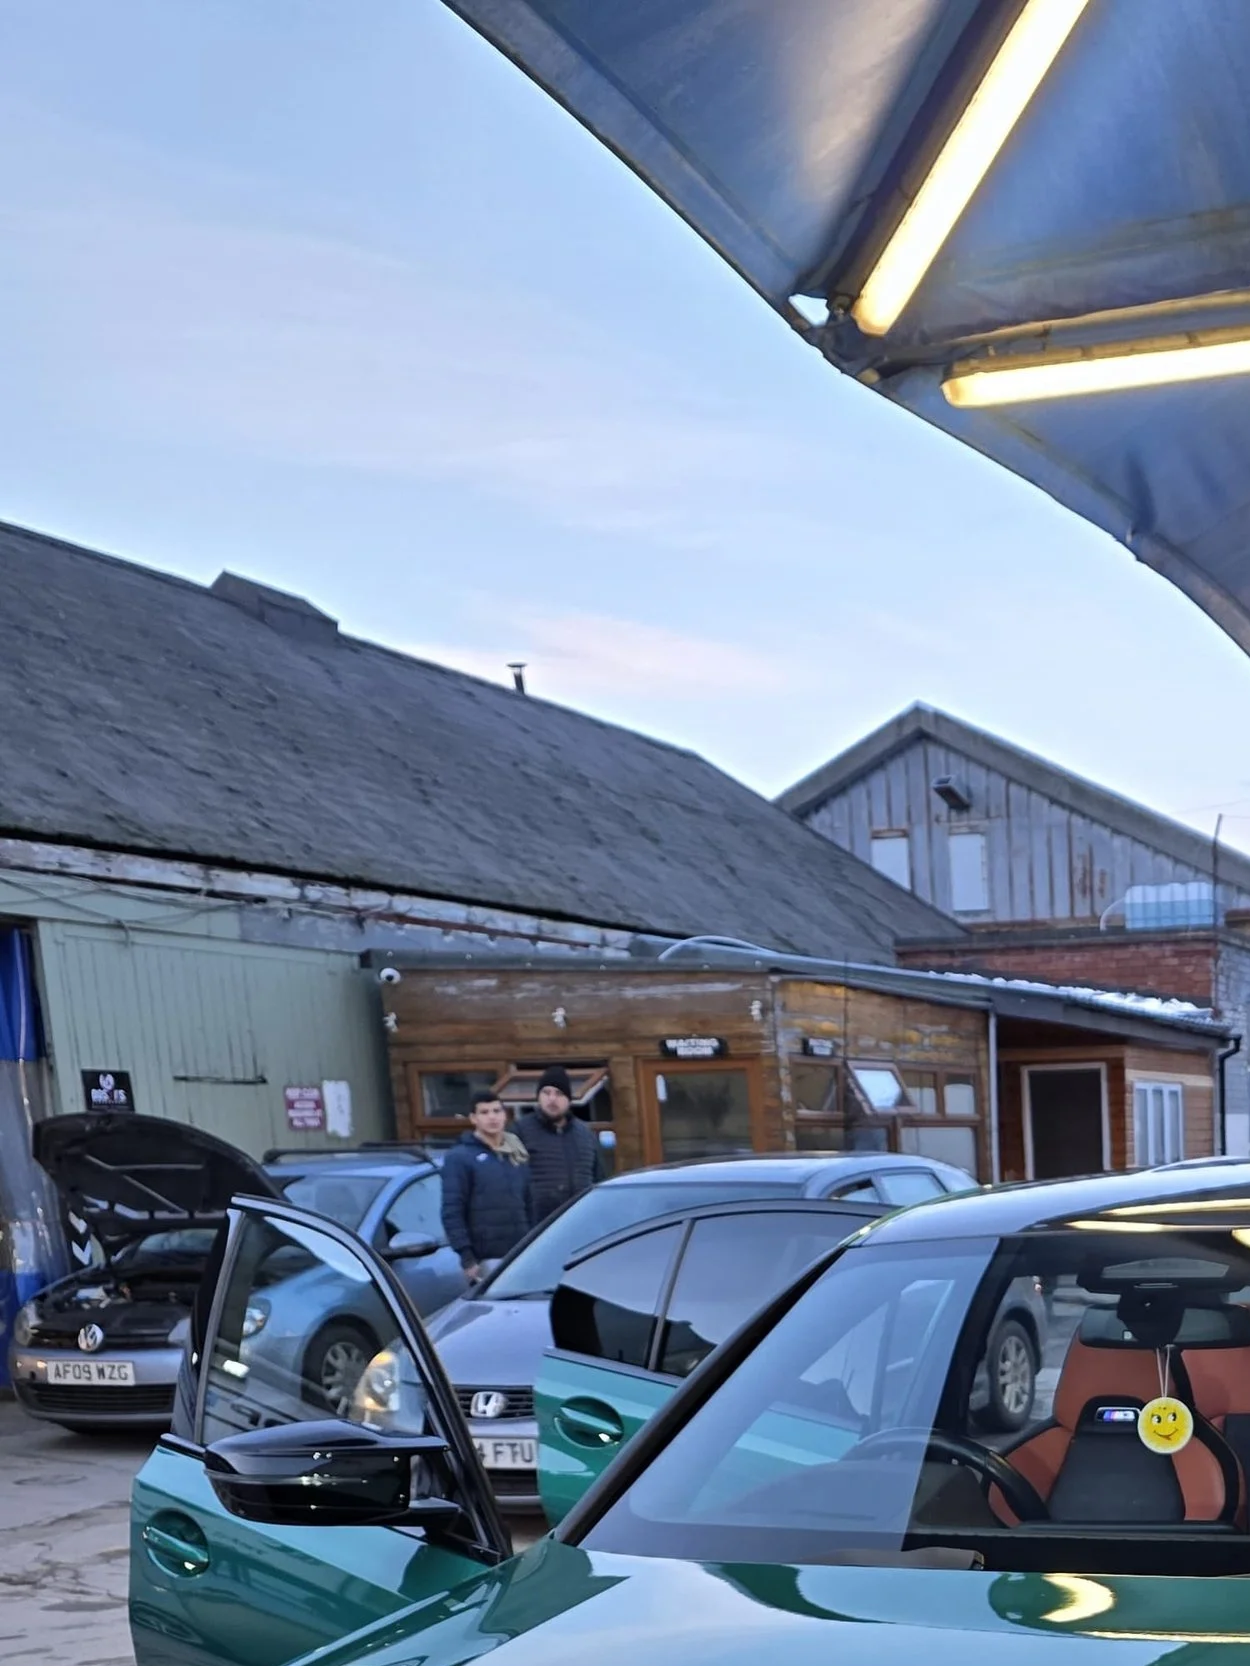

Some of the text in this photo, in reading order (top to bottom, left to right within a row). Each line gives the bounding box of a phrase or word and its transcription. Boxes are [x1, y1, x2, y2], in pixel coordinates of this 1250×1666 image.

[54, 1364, 129, 1381] AF09 WZG
[492, 1442, 534, 1463] FTU
